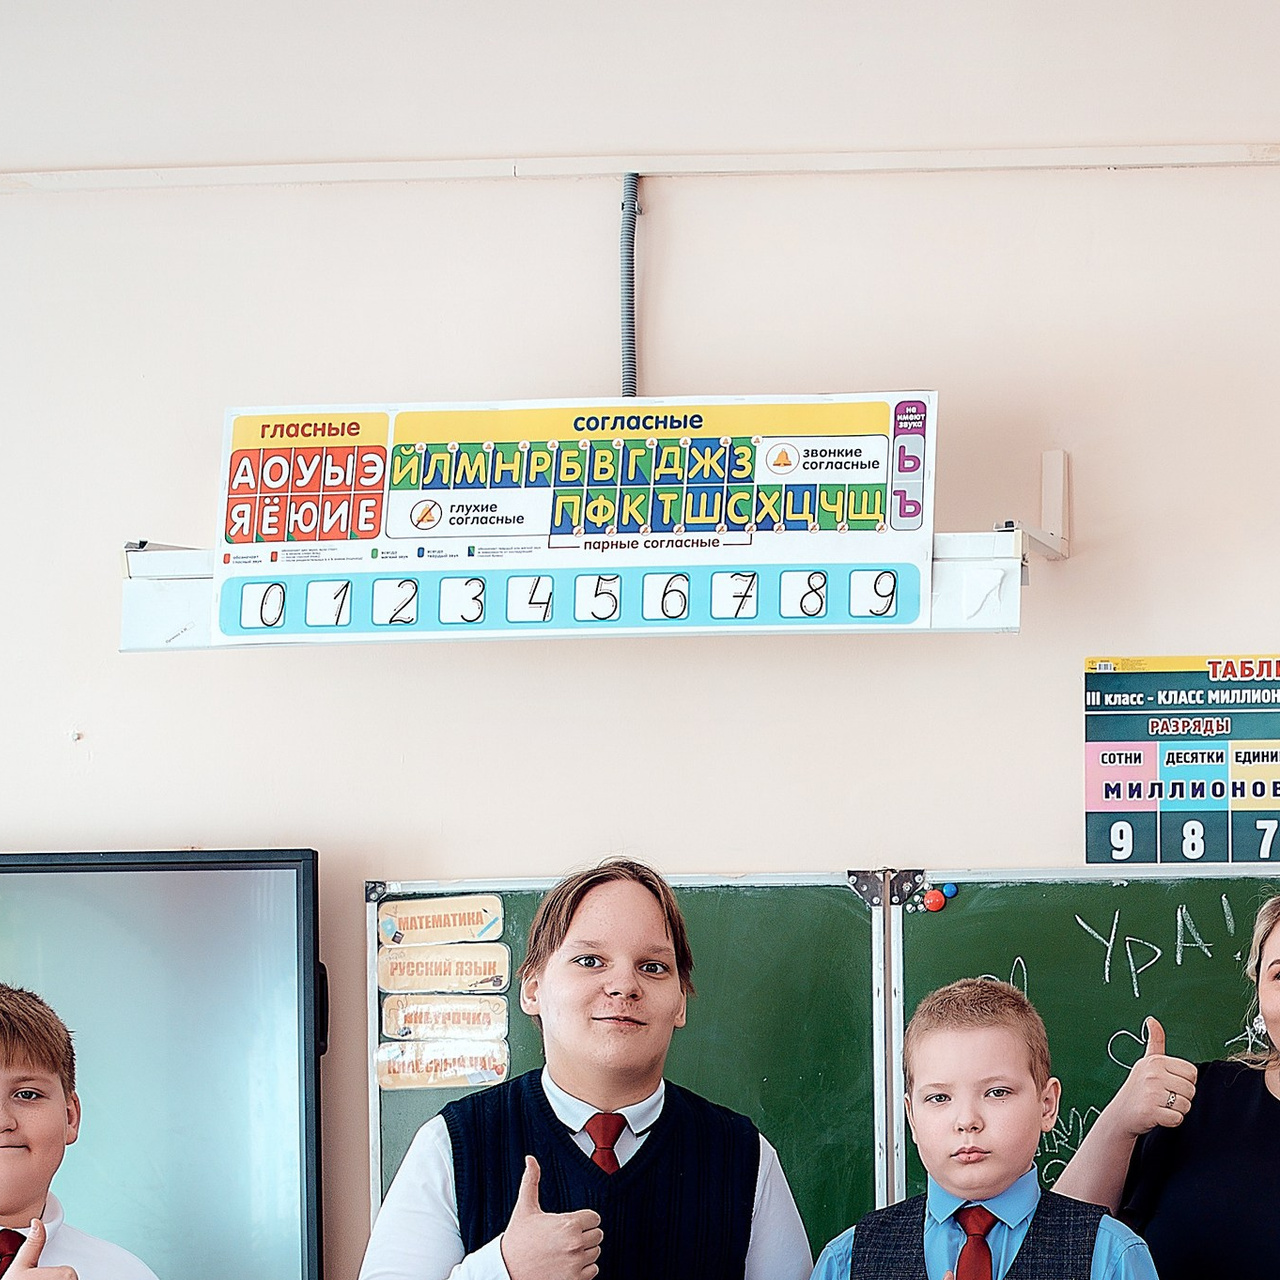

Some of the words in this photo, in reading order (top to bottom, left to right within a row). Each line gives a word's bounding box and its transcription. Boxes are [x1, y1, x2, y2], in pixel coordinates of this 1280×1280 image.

[260, 421, 361, 439] гласные
[573, 412, 704, 433] согласные
[803, 446, 863, 459] звонкие
[803, 458, 880, 472] согласные
[449, 501, 498, 516] глухие
[449, 513, 525, 526] согласные
[584, 537, 639, 552] парные
[643, 536, 720, 550] согласные
[260, 583, 285, 627] 0
[333, 580, 351, 626] 1
[388, 578, 418, 625] 2
[461, 578, 485, 623] 3
[528, 576, 554, 622] 4
[591, 573, 619, 620] 5
[662, 573, 689, 619] 6
[730, 572, 757, 618] 7
[800, 572, 827, 617] 8
[869, 571, 897, 616] 9
[1086, 691, 1101, 706] III
[1104, 691, 1144, 706] класс
[1157, 690, 1203, 705] КЛАСС
[1149, 717, 1231, 735] РАЗРЯДЫ
[1101, 752, 1142, 766] СОТНИ
[1165, 751, 1225, 766] ДЕСЯТКИ
[1109, 820, 1134, 860] 9
[1181, 819, 1205, 859] 8
[1256, 819, 1278, 858] 7
[398, 911, 485, 932] МАТЕМАТИКА
[1075, 893, 1242, 998] УРА!
[389, 959, 450, 977] РУССКИЙ
[455, 961, 497, 976] ЯЗЫК
